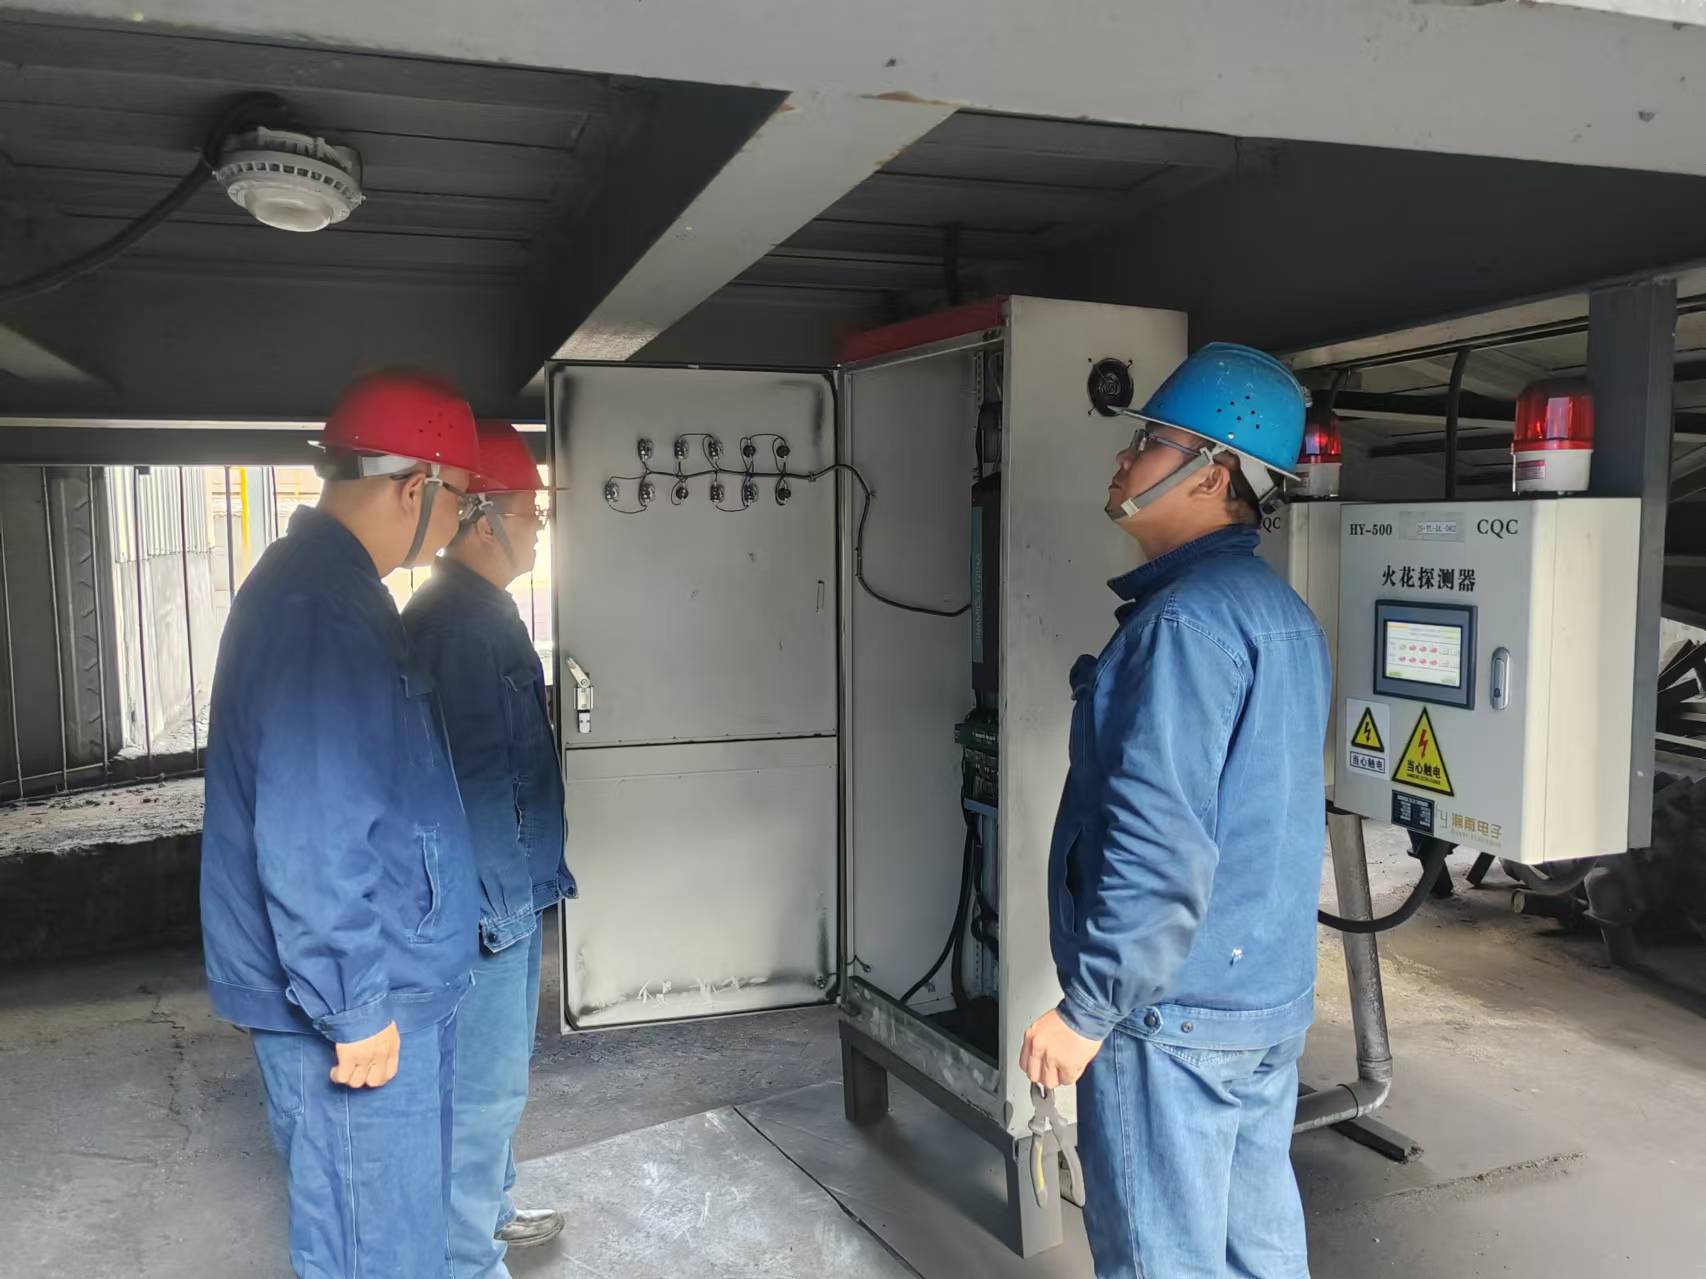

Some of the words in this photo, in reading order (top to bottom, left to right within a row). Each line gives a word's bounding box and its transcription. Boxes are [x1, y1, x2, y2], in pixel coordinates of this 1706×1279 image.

[1262, 516, 1281, 533] QC
[1350, 523, 1392, 537] HY-500
[1477, 519, 1519, 539] CQC
[1382, 565, 1476, 592] 火花探测器
[1352, 754, 1385, 771] 当心触电
[1406, 759, 1441, 779] 当心触电
